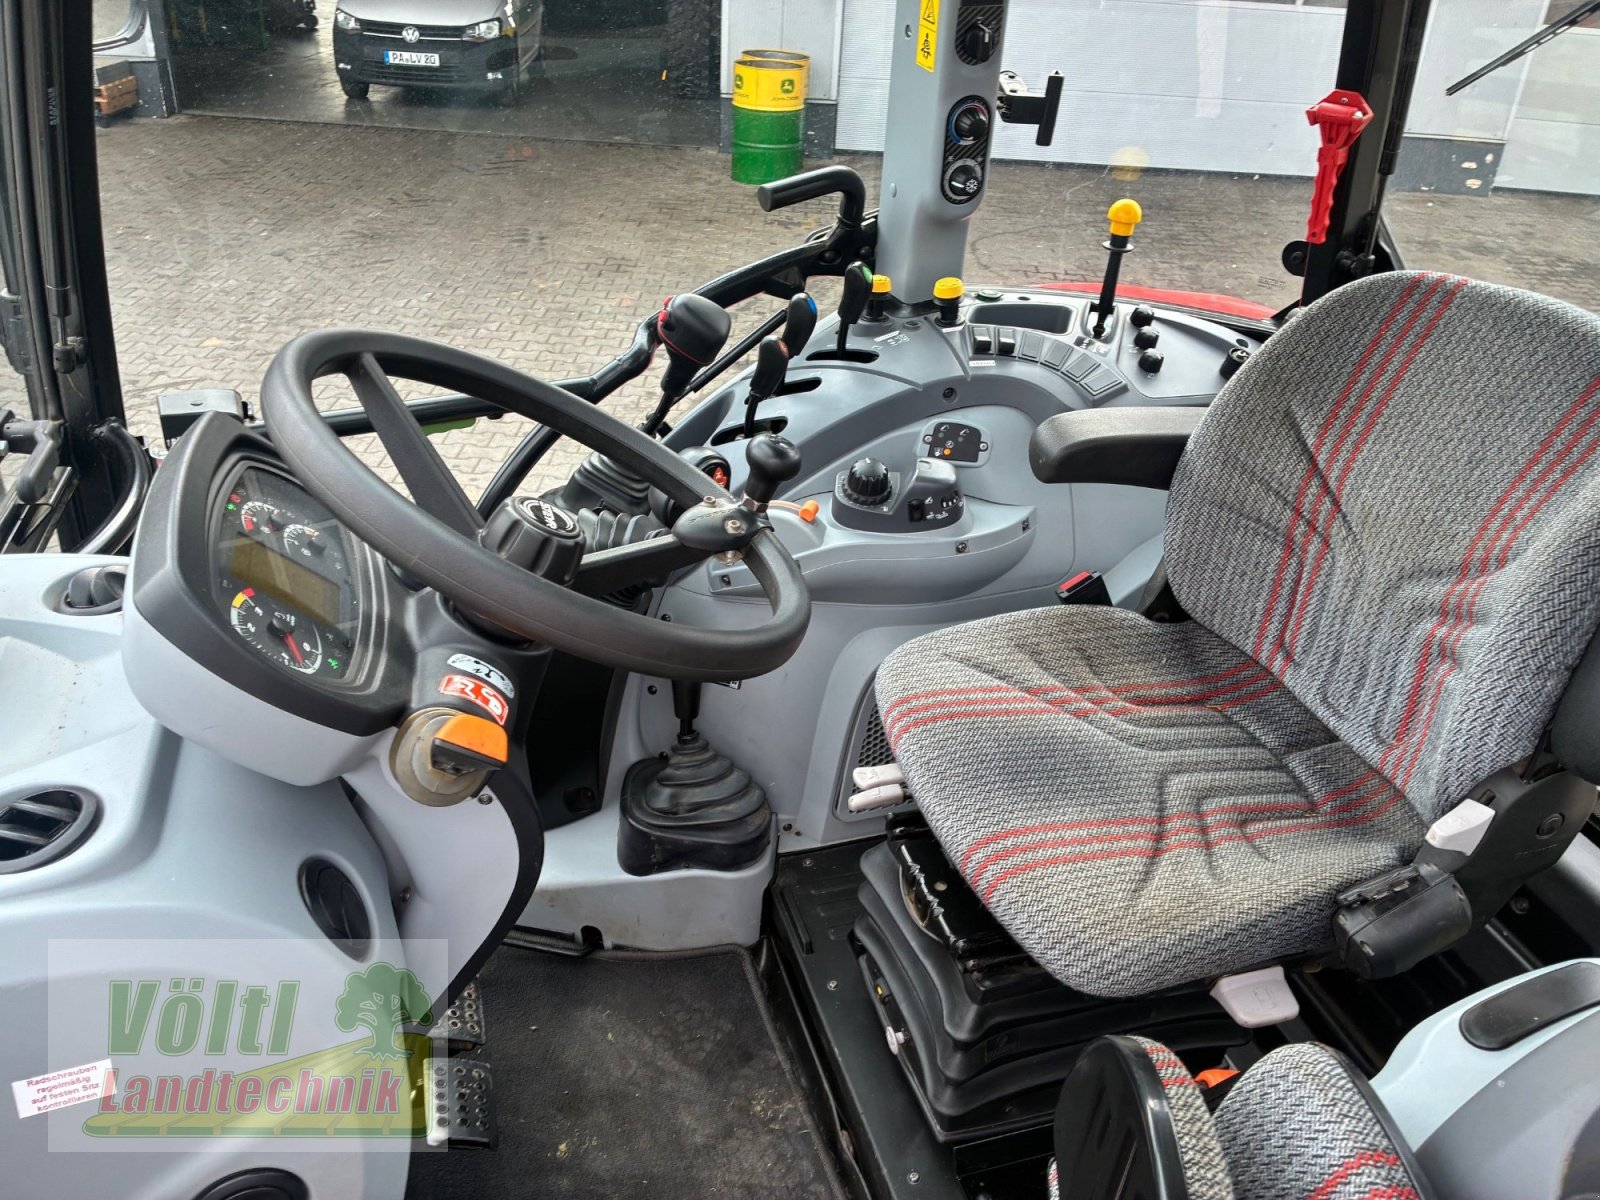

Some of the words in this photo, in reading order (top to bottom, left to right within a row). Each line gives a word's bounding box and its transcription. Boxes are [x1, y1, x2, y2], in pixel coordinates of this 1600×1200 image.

[26, 1066, 97, 1087] Radschrauben
[31, 1094, 47, 1105] auf
[50, 1089, 80, 1100] festen
[82, 1083, 100, 1092] Sitz
[37, 1093, 97, 1111] kontrollieren
